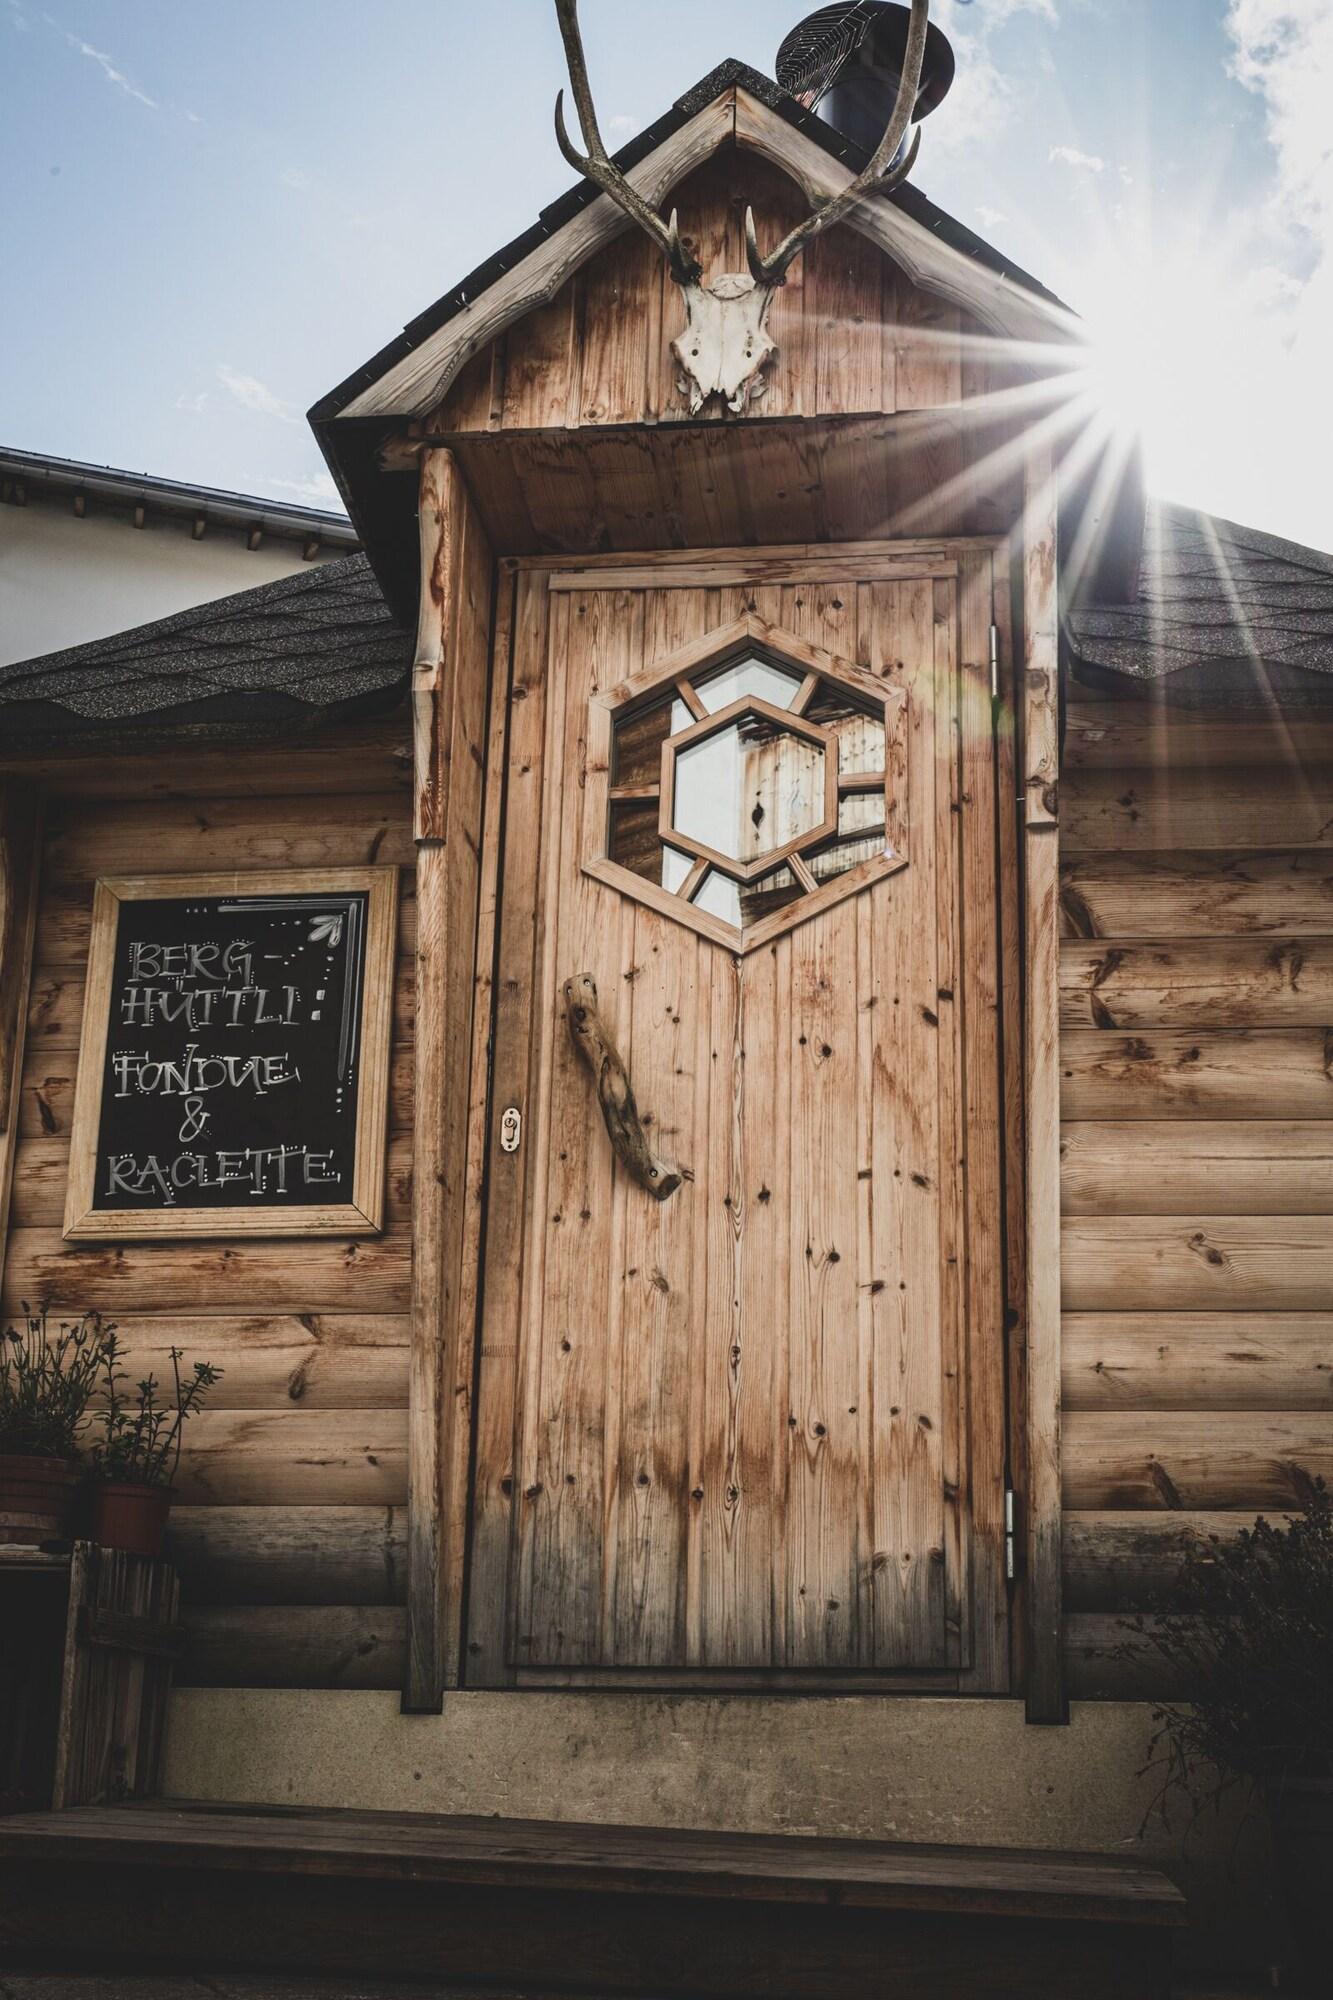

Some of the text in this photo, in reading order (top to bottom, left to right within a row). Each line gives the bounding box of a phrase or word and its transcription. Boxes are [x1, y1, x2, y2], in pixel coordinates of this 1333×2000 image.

[112, 1044, 301, 1096] FONDUE
[178, 1096, 211, 1142] &
[105, 1144, 341, 1204] RACLETTE
